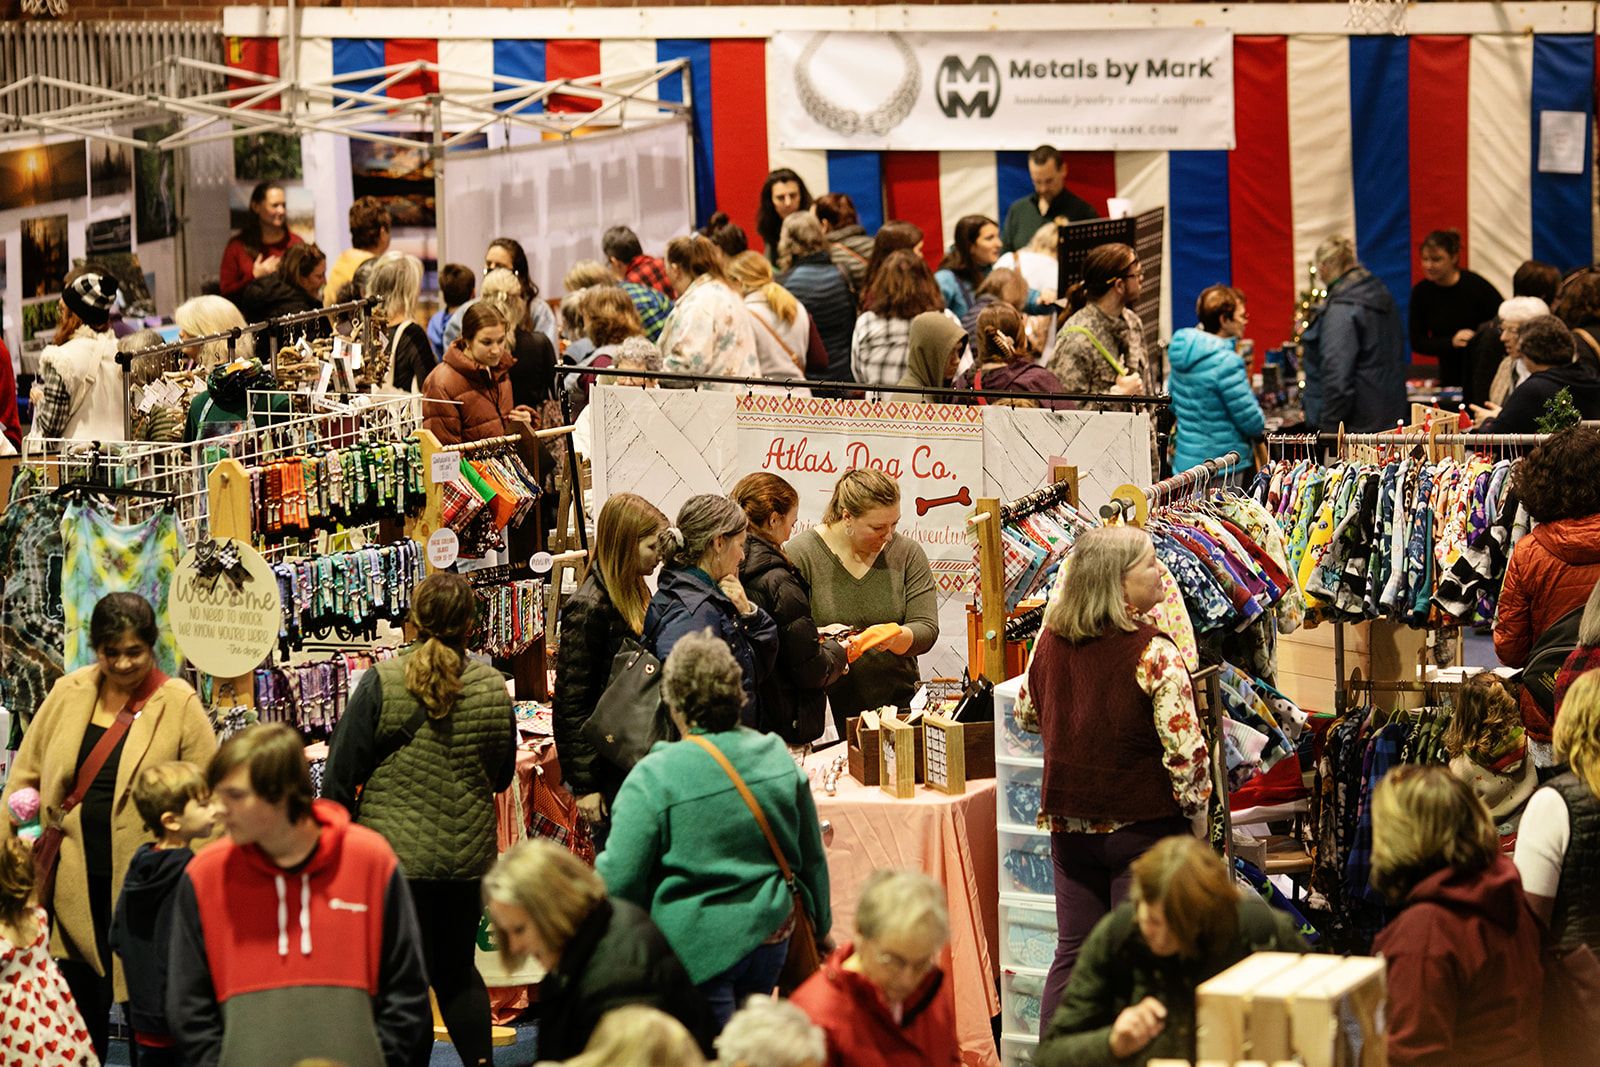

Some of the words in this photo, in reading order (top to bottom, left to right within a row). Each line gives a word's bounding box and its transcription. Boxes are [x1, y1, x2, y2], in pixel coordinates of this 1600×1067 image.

[1009, 58, 1098, 79] Metals
[1106, 58, 1139, 85] by
[1146, 58, 1213, 78] Mark
[1046, 125, 1179, 135] METALSBYMARK.COM
[762, 436, 838, 474] Atlas
[911, 444, 958, 481] Co.
